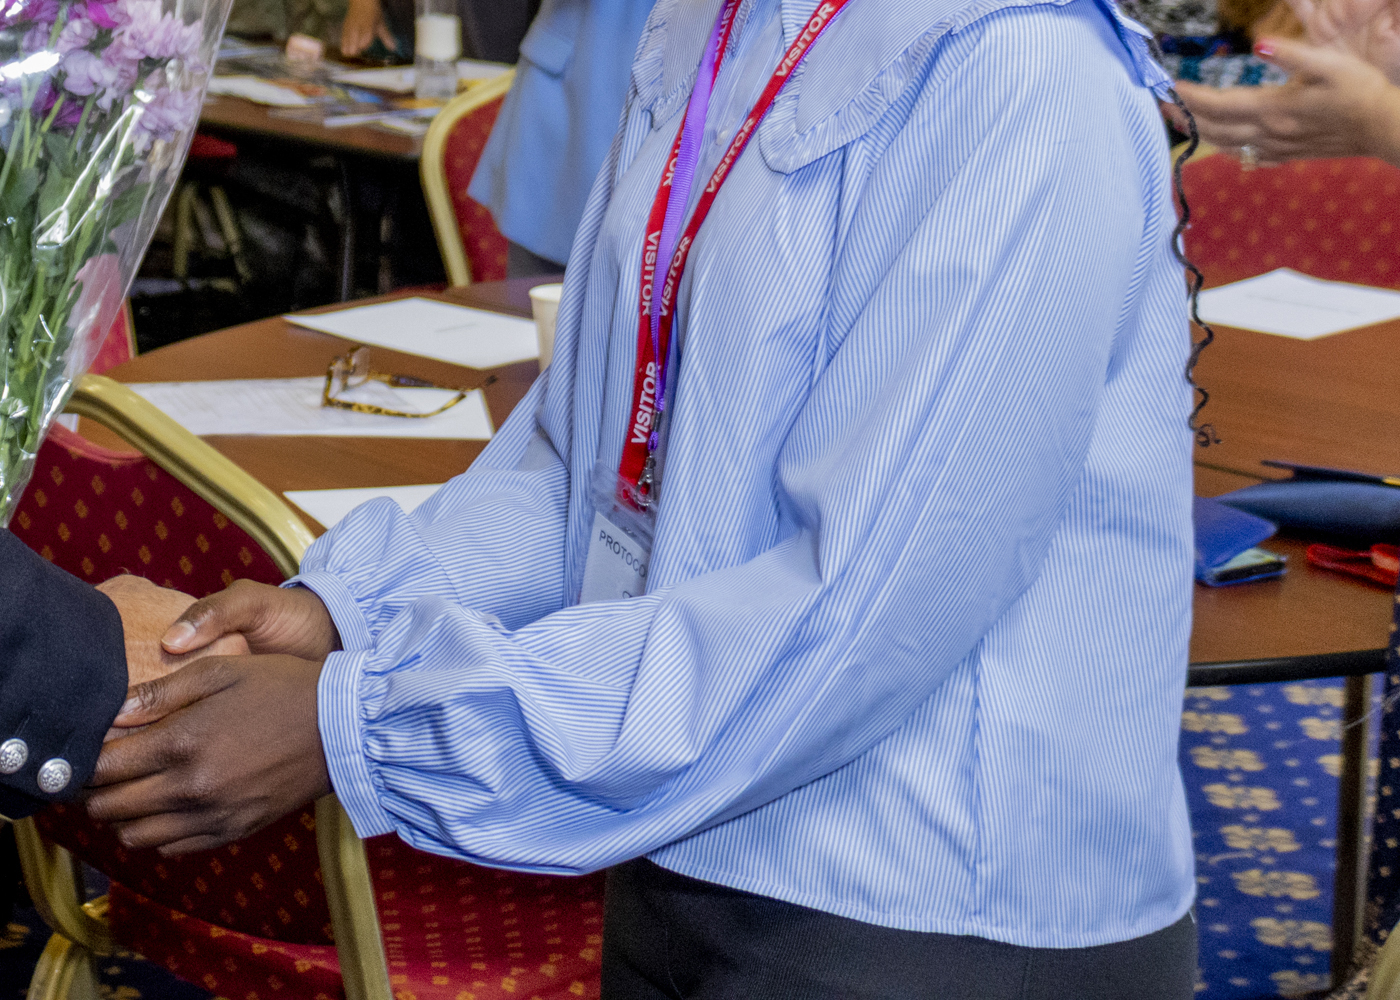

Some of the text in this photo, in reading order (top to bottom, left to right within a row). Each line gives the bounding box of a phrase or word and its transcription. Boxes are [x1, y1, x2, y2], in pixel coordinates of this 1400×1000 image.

[775, 2, 836, 77] VISITOR
[705, 118, 755, 194] VISITOR
[642, 230, 661, 316] VISITOR
[660, 236, 691, 316] VISITOR
[631, 361, 662, 443] VISITOR
[599, 529, 647, 578] PROTOCO
